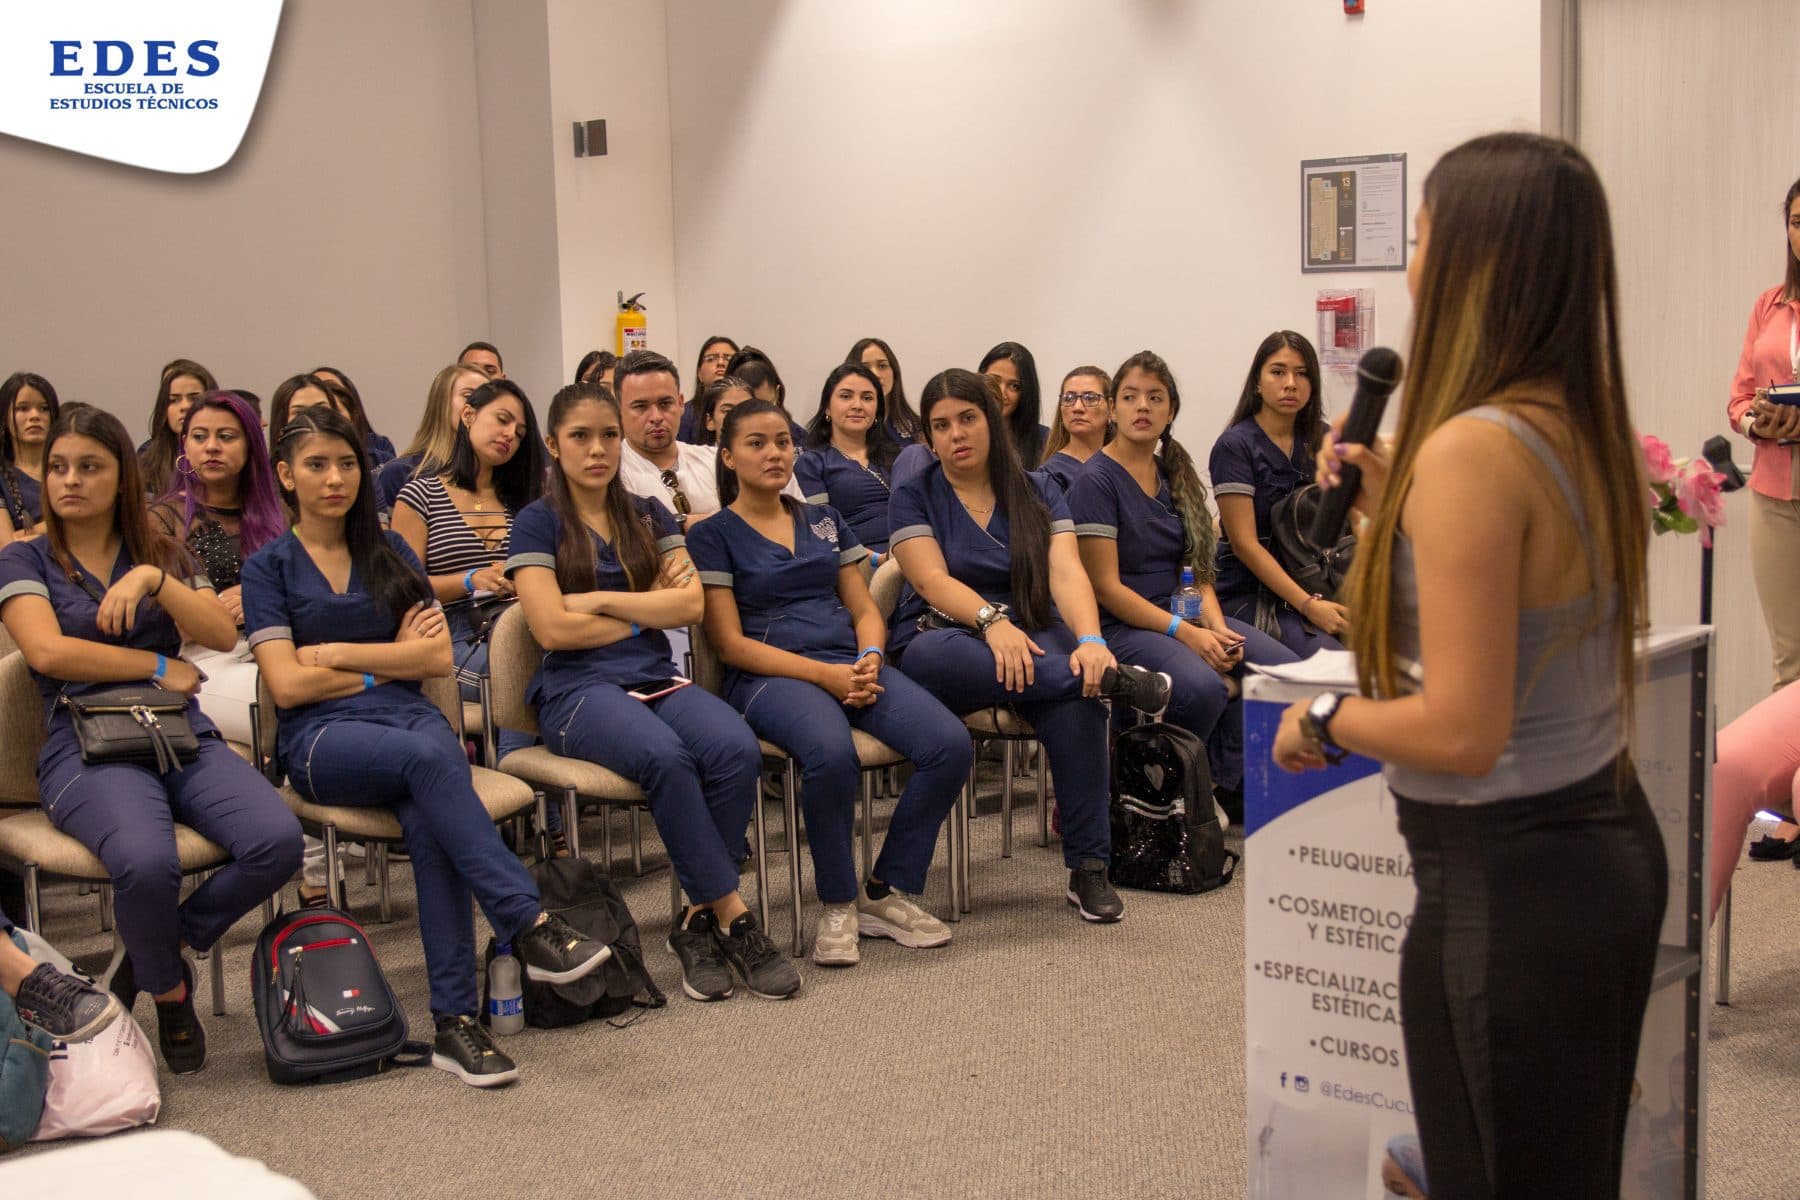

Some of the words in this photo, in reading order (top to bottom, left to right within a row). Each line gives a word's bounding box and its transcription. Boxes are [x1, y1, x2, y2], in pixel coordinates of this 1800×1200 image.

[1307, 922, 1318, 940] Y
[1325, 925, 1401, 954] ESTÉTIC
[1263, 960, 1399, 1000] ESPECIALIZAC
[1312, 993, 1404, 1026] ESTÉTICA
[1320, 1036, 1399, 1067] CURSOS
[1320, 1080, 1415, 1114] @EdesCucu
